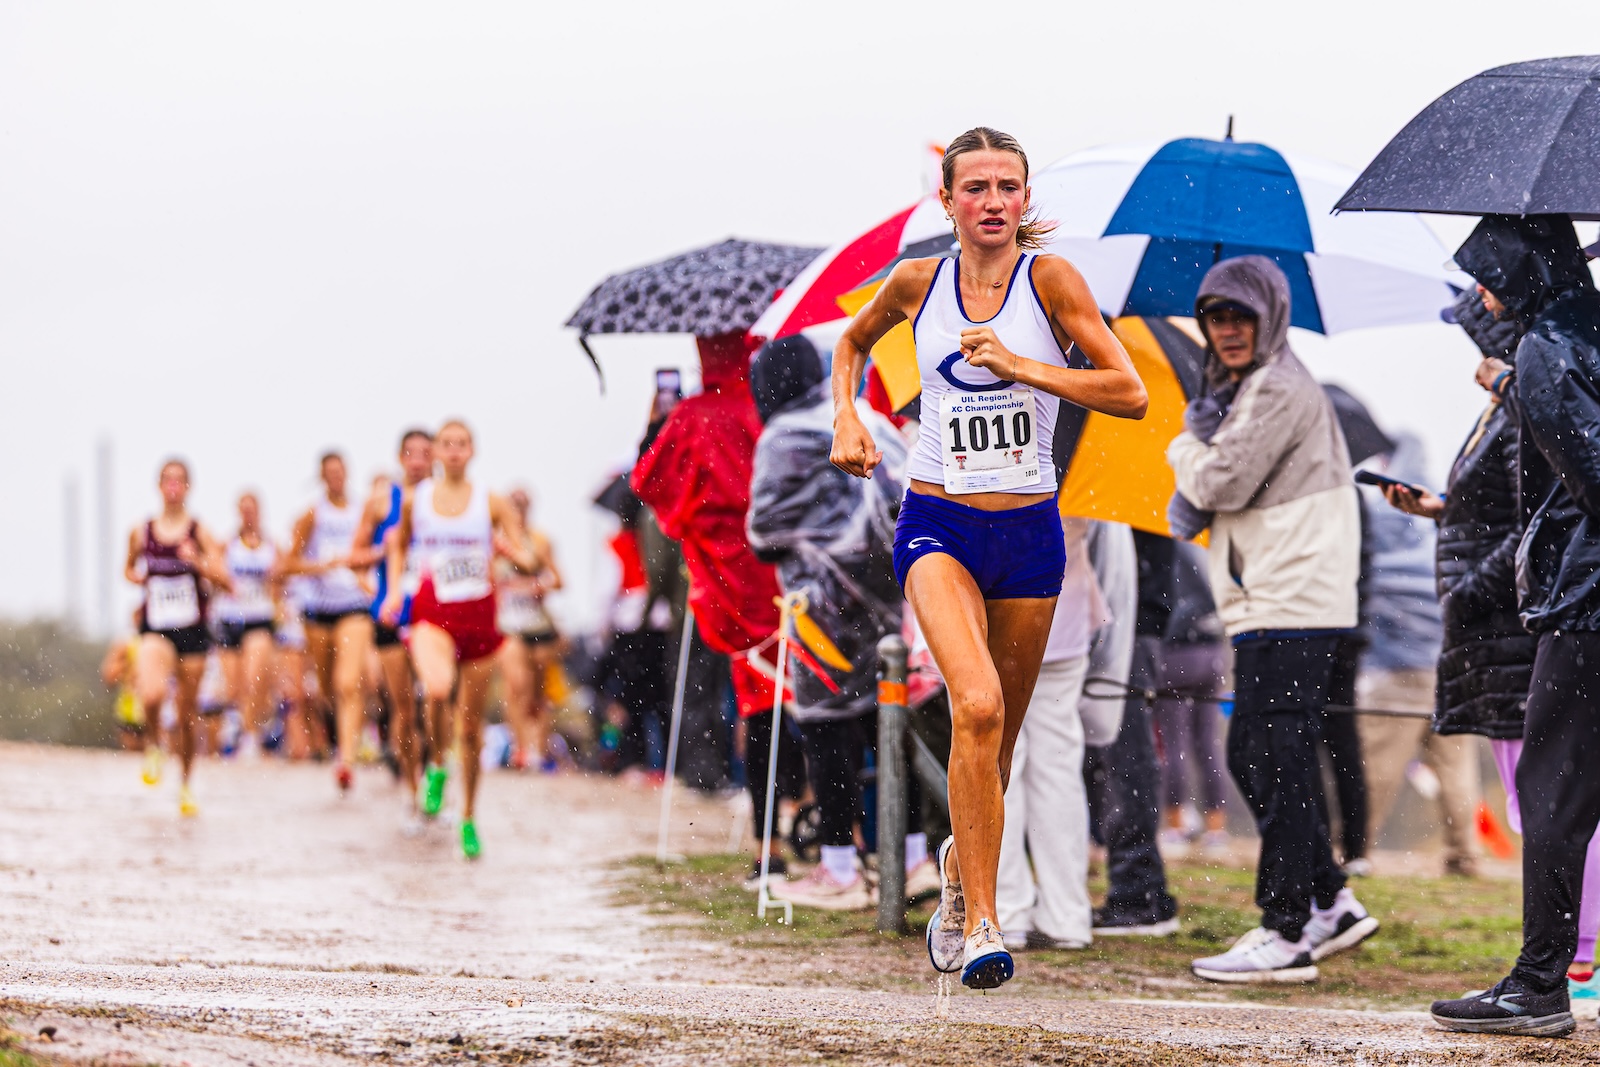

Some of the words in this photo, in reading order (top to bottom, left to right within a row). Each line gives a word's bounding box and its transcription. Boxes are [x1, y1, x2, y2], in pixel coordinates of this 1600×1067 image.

[978, 394, 1008, 402] Region
[965, 401, 1024, 412] Championship
[948, 411, 1031, 452] 1010
[1025, 469, 1038, 477] 1010
